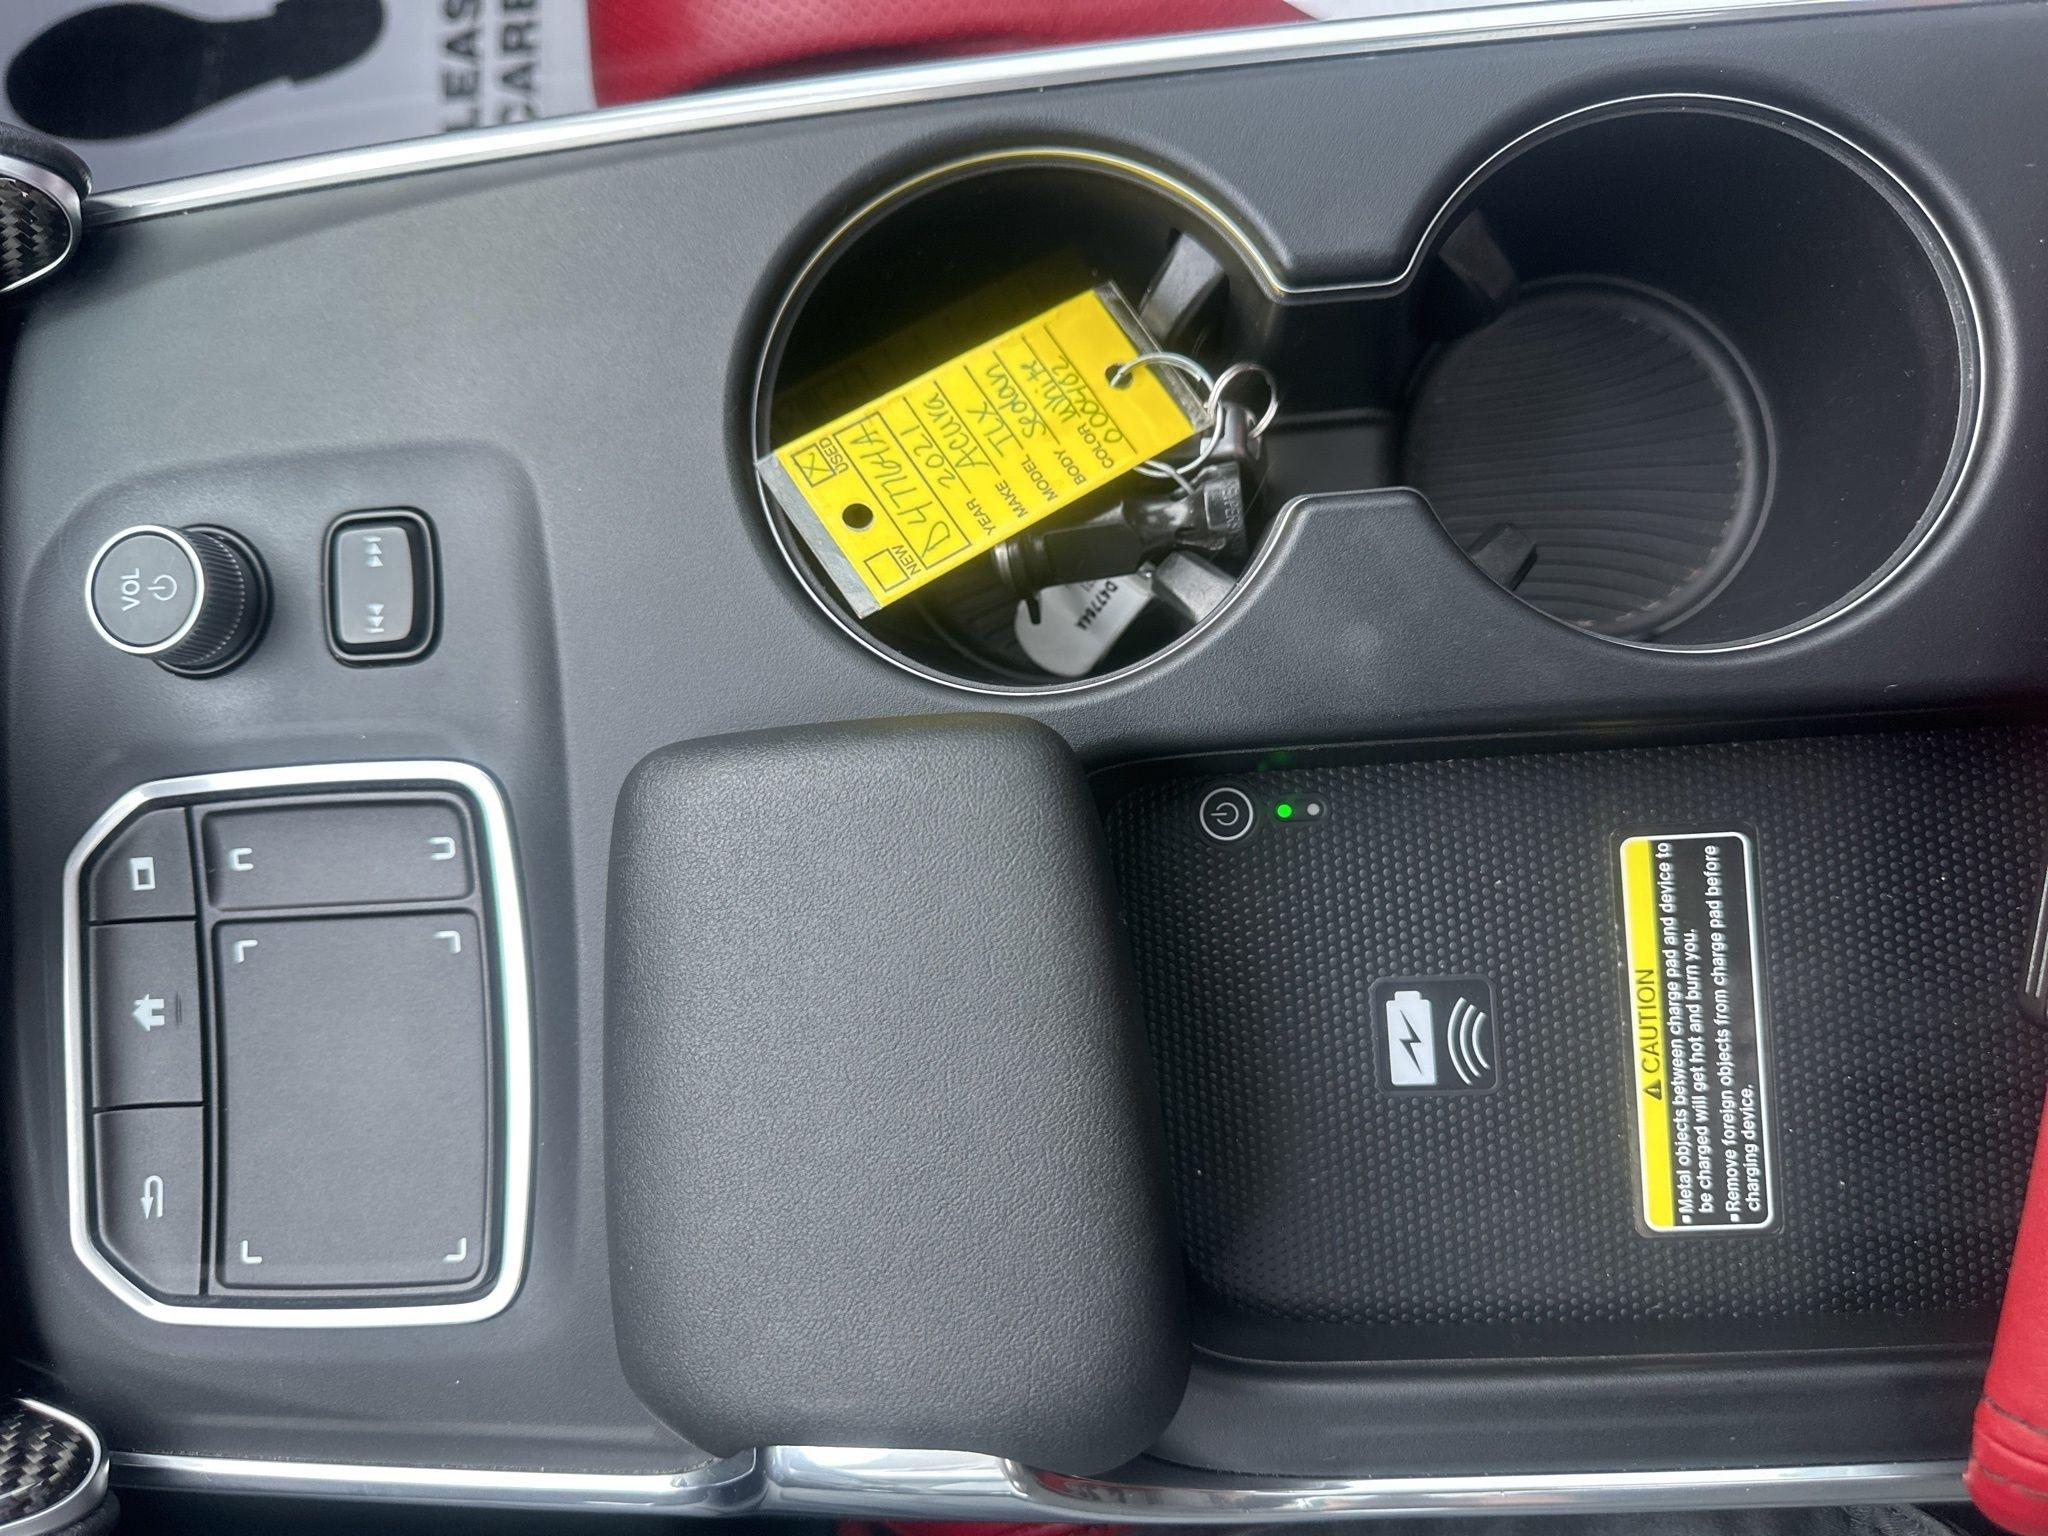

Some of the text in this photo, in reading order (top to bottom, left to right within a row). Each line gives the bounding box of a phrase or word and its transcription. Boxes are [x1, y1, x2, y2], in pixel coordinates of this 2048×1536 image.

[819, 436, 849, 474] USED
[923, 392, 990, 468] Acura
[965, 400, 1014, 458] TLX
[1077, 422, 1115, 469] COLOR
[900, 425, 957, 490] 2021
[1021, 453, 1058, 502] MODEL
[1053, 449, 1087, 486] BODY
[966, 498, 996, 535] YEAR
[994, 479, 1029, 518] MAKE
[892, 544, 922, 576] NEW
[121, 567, 141, 612] VOL
[1635, 969, 1661, 1073] CAUTION
[1655, 842, 1695, 1214] Metal objects between charge pad and device to
[1703, 844, 1741, 1212] Remove foreign objects from charge pad before
[1683, 928, 1714, 1213] be charged will get hot and burn you.
[1739, 1084, 1762, 1212] charging device.
